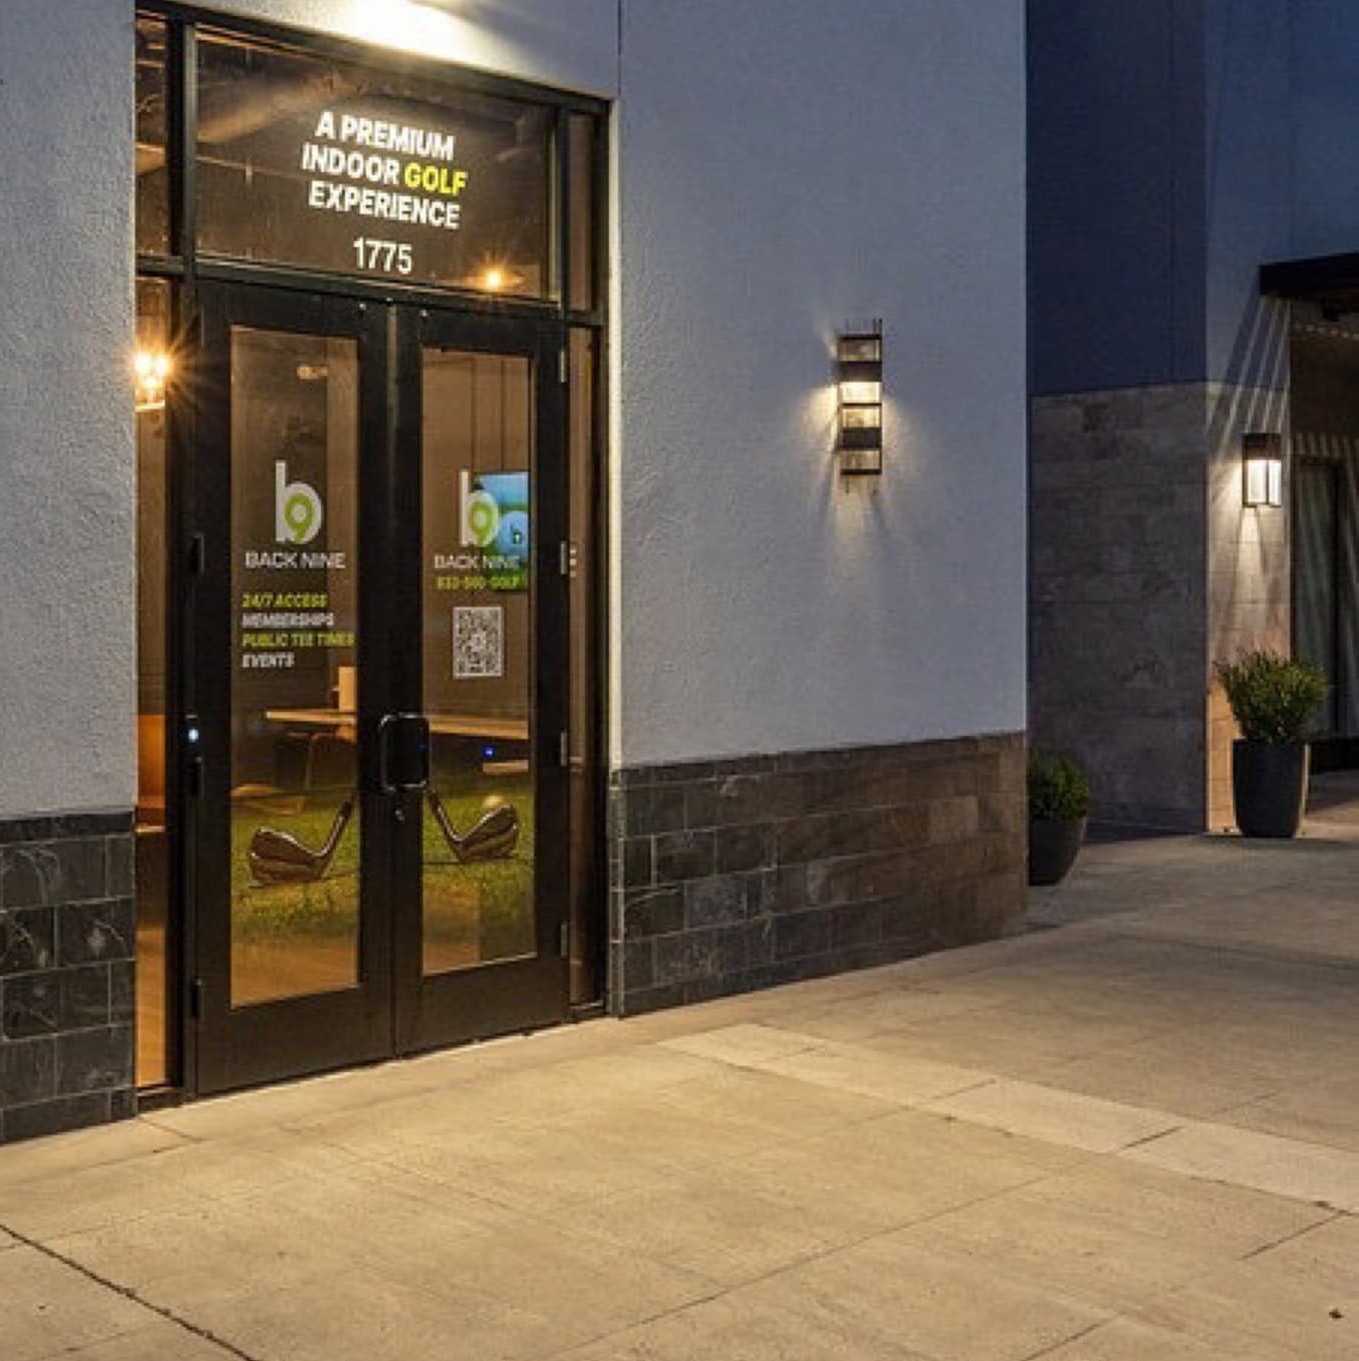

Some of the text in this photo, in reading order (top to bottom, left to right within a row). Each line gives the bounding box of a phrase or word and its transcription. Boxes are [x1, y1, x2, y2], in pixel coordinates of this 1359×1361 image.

[314, 111, 456, 161] A PREMIUM
[301, 142, 468, 196] INDOOR GOLF
[308, 180, 461, 230] EXPERIENCE
[353, 237, 413, 275] 1775
[244, 551, 346, 570] BACK NINE
[434, 554, 479, 570] BACK
[273, 593, 328, 609] ACCESS
[242, 612, 334, 629] MEMBERSHIPS
[242, 632, 289, 648] PUBLIC
[242, 652, 296, 669] EVENTS
